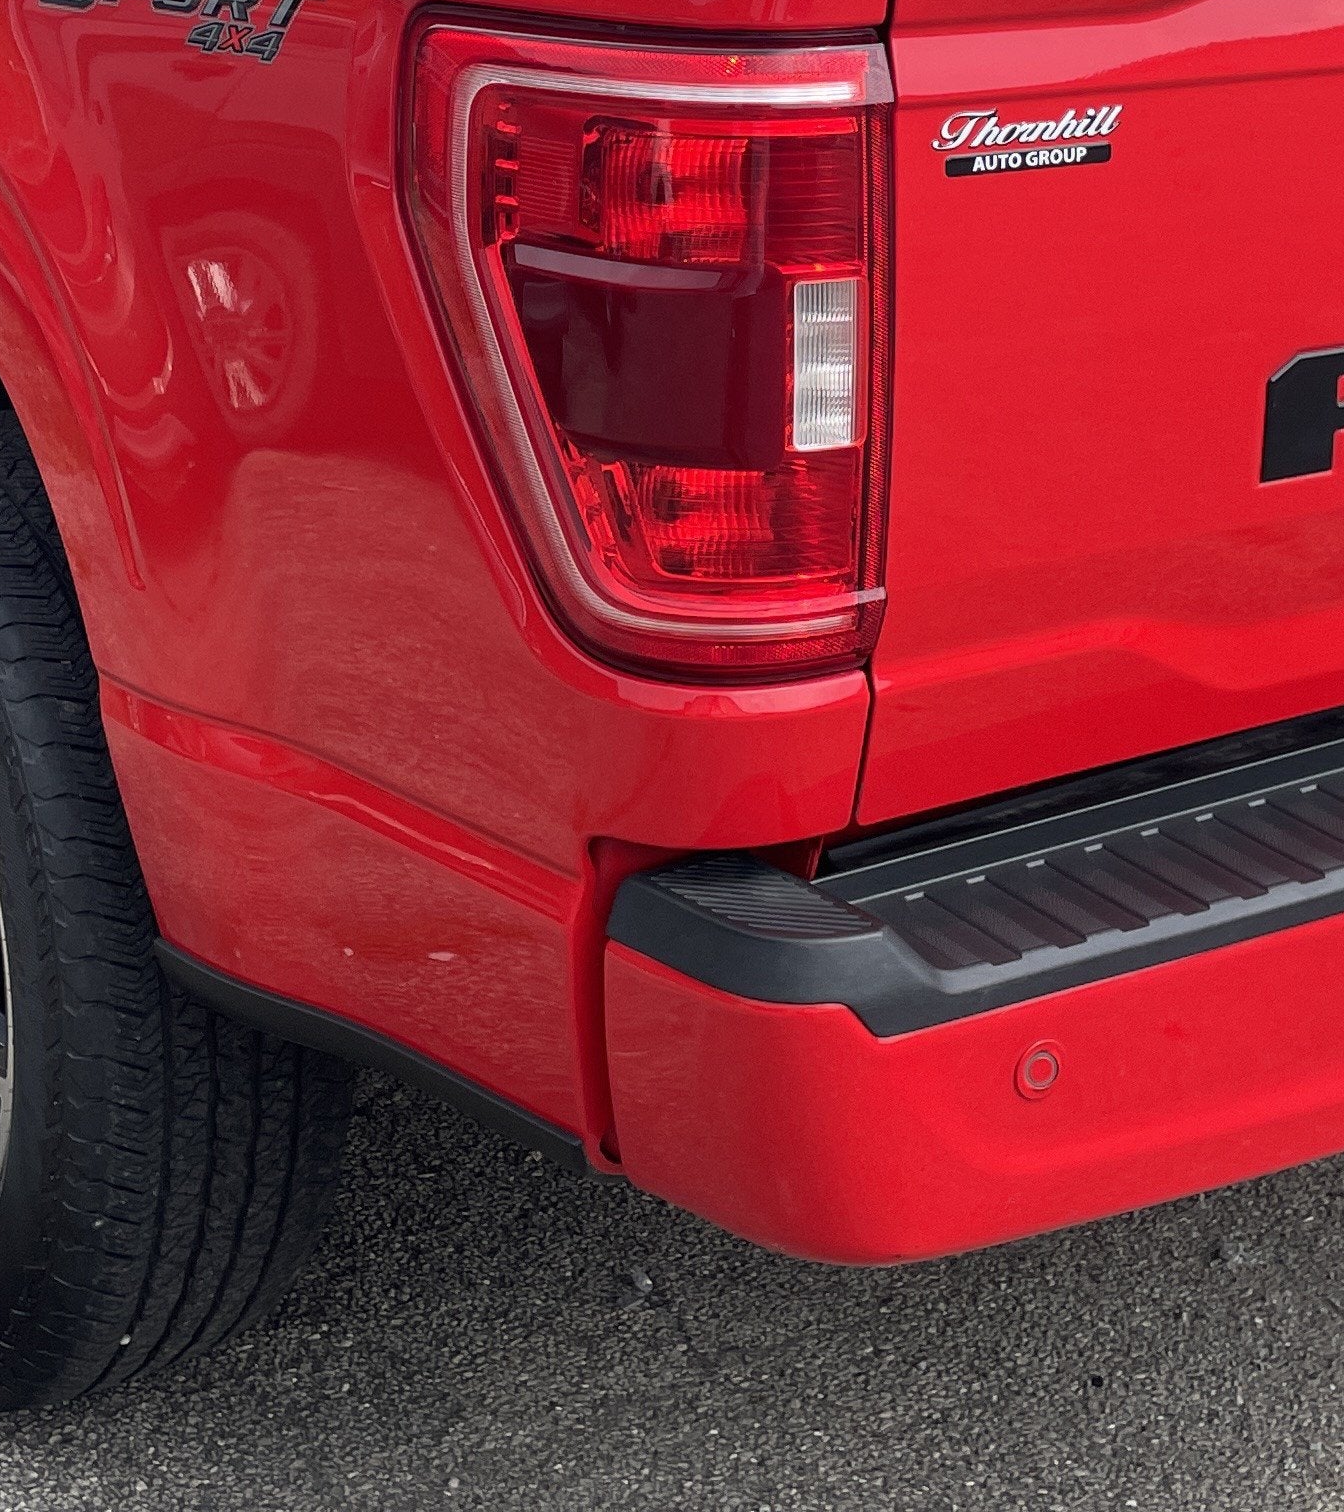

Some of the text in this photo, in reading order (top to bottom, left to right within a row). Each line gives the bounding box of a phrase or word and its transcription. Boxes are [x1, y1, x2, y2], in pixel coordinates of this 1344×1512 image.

[931, 104, 1124, 151] Thornhill
[972, 146, 1088, 172] AUTO GROUP
